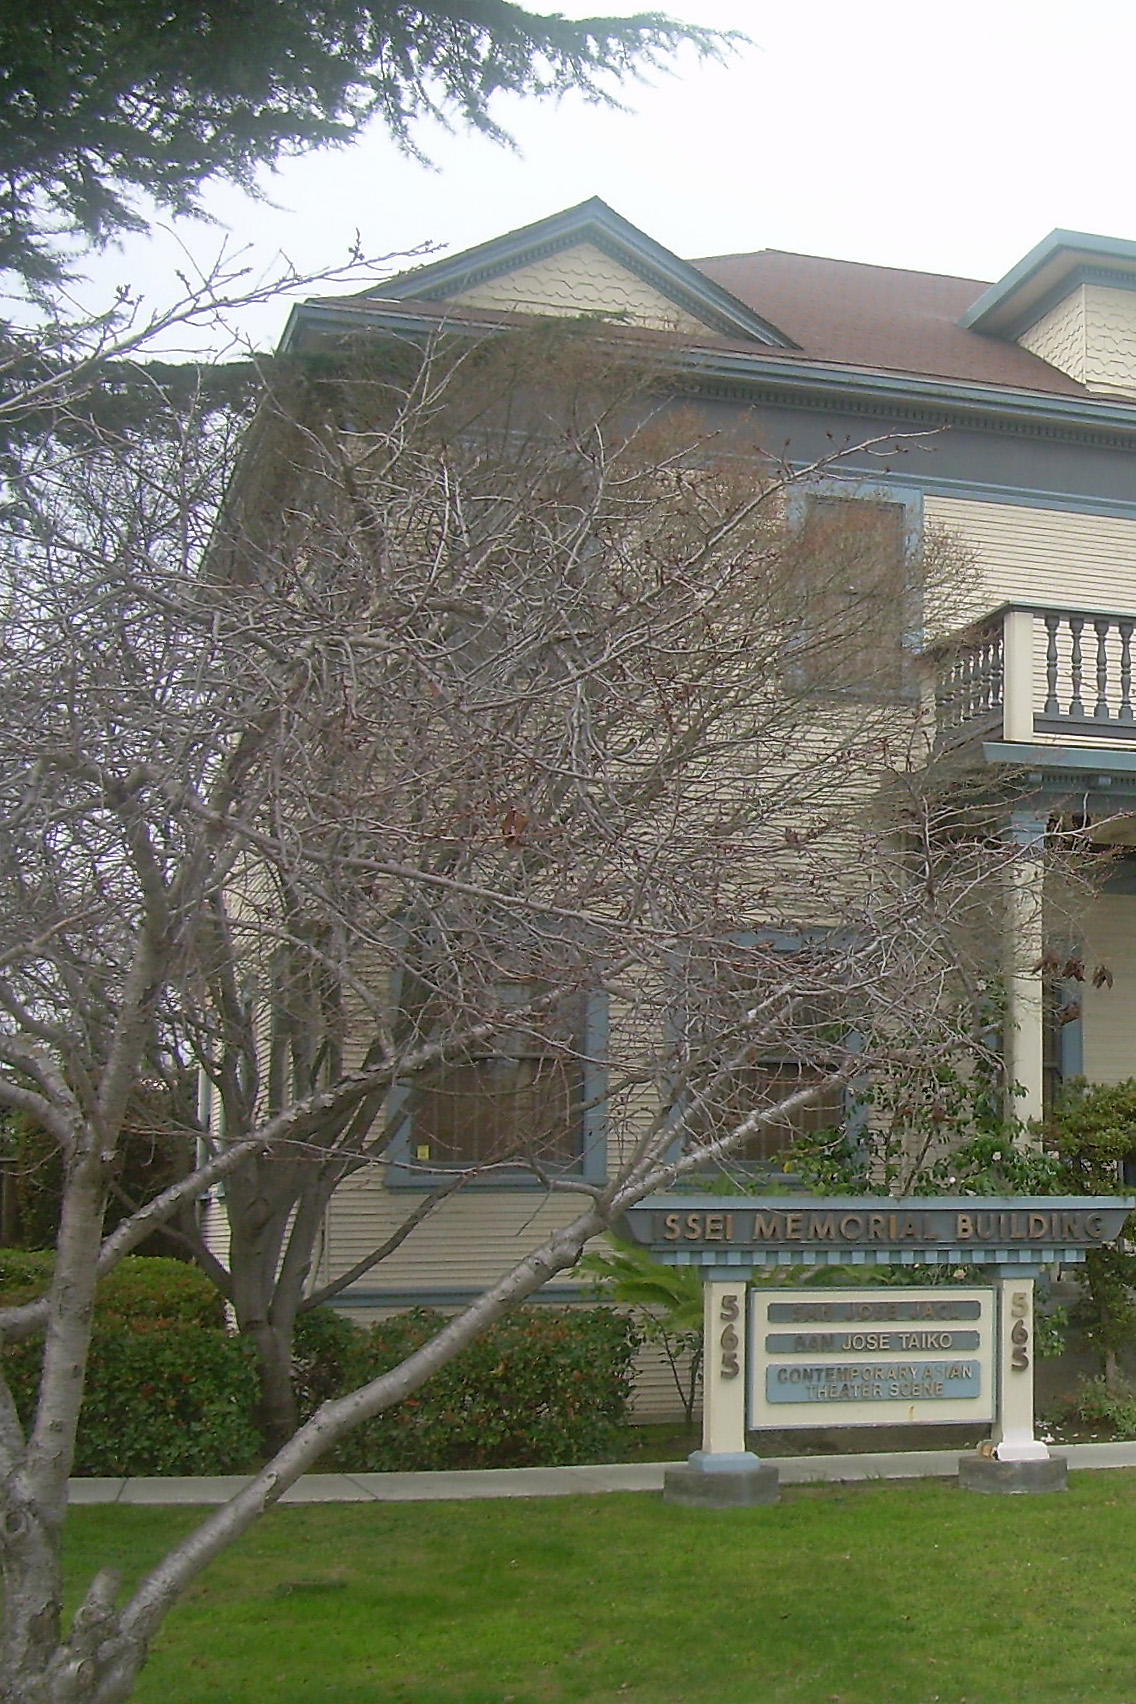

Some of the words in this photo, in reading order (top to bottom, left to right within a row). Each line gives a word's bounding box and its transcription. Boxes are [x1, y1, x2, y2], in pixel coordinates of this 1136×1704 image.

[752, 1212, 937, 1240] MEMORIAL
[956, 1212, 1105, 1240] BUILDING
[793, 1304, 833, 1321] SAN
[844, 1303, 897, 1320] JOSE
[720, 1294, 739, 1379] 565
[794, 1333, 834, 1350] SAN
[842, 1333, 890, 1350] JOSE
[898, 1332, 952, 1349] TAIKO
[1010, 1291, 1029, 1373] 565
[778, 1365, 917, 1384] CONTEMPORARY
[806, 1382, 883, 1400] THEATER
[889, 1381, 944, 1397] SCENE
